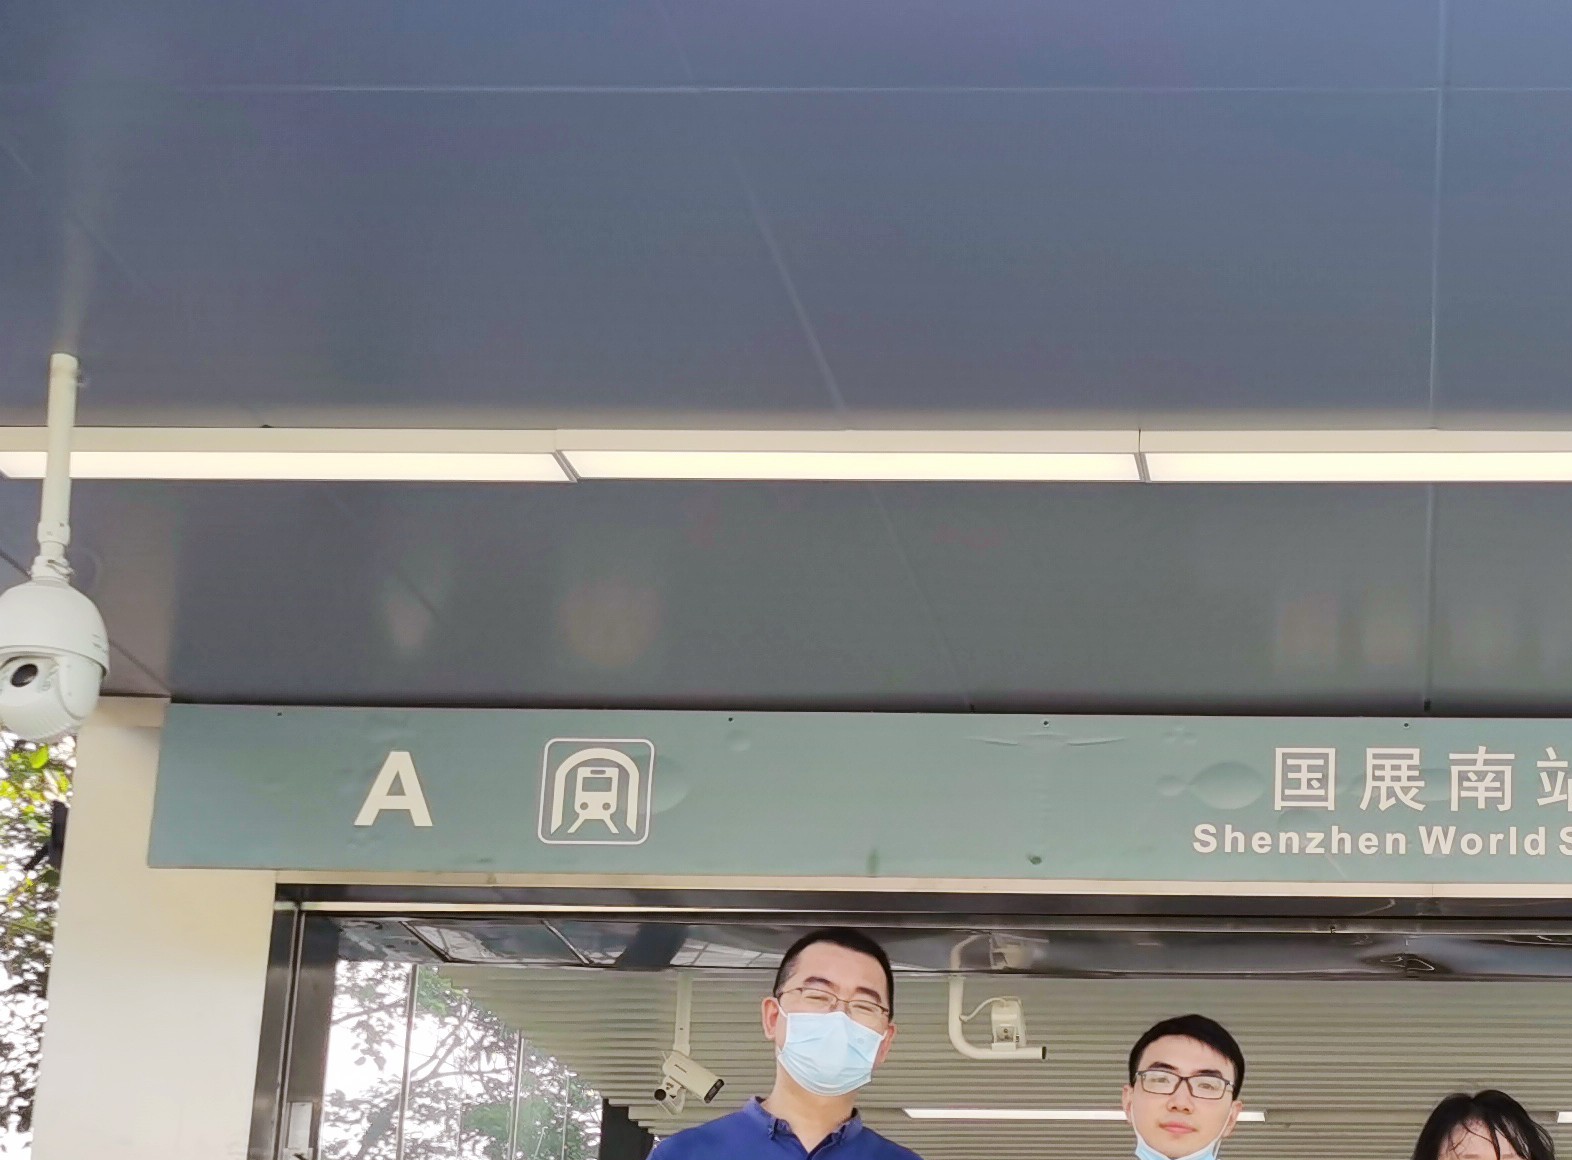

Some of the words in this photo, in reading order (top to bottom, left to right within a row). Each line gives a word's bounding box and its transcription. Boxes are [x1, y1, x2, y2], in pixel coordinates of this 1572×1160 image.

[353, 750, 433, 827] A
[1192, 823, 1407, 855] Shenzhen
[1418, 825, 1547, 857] World
